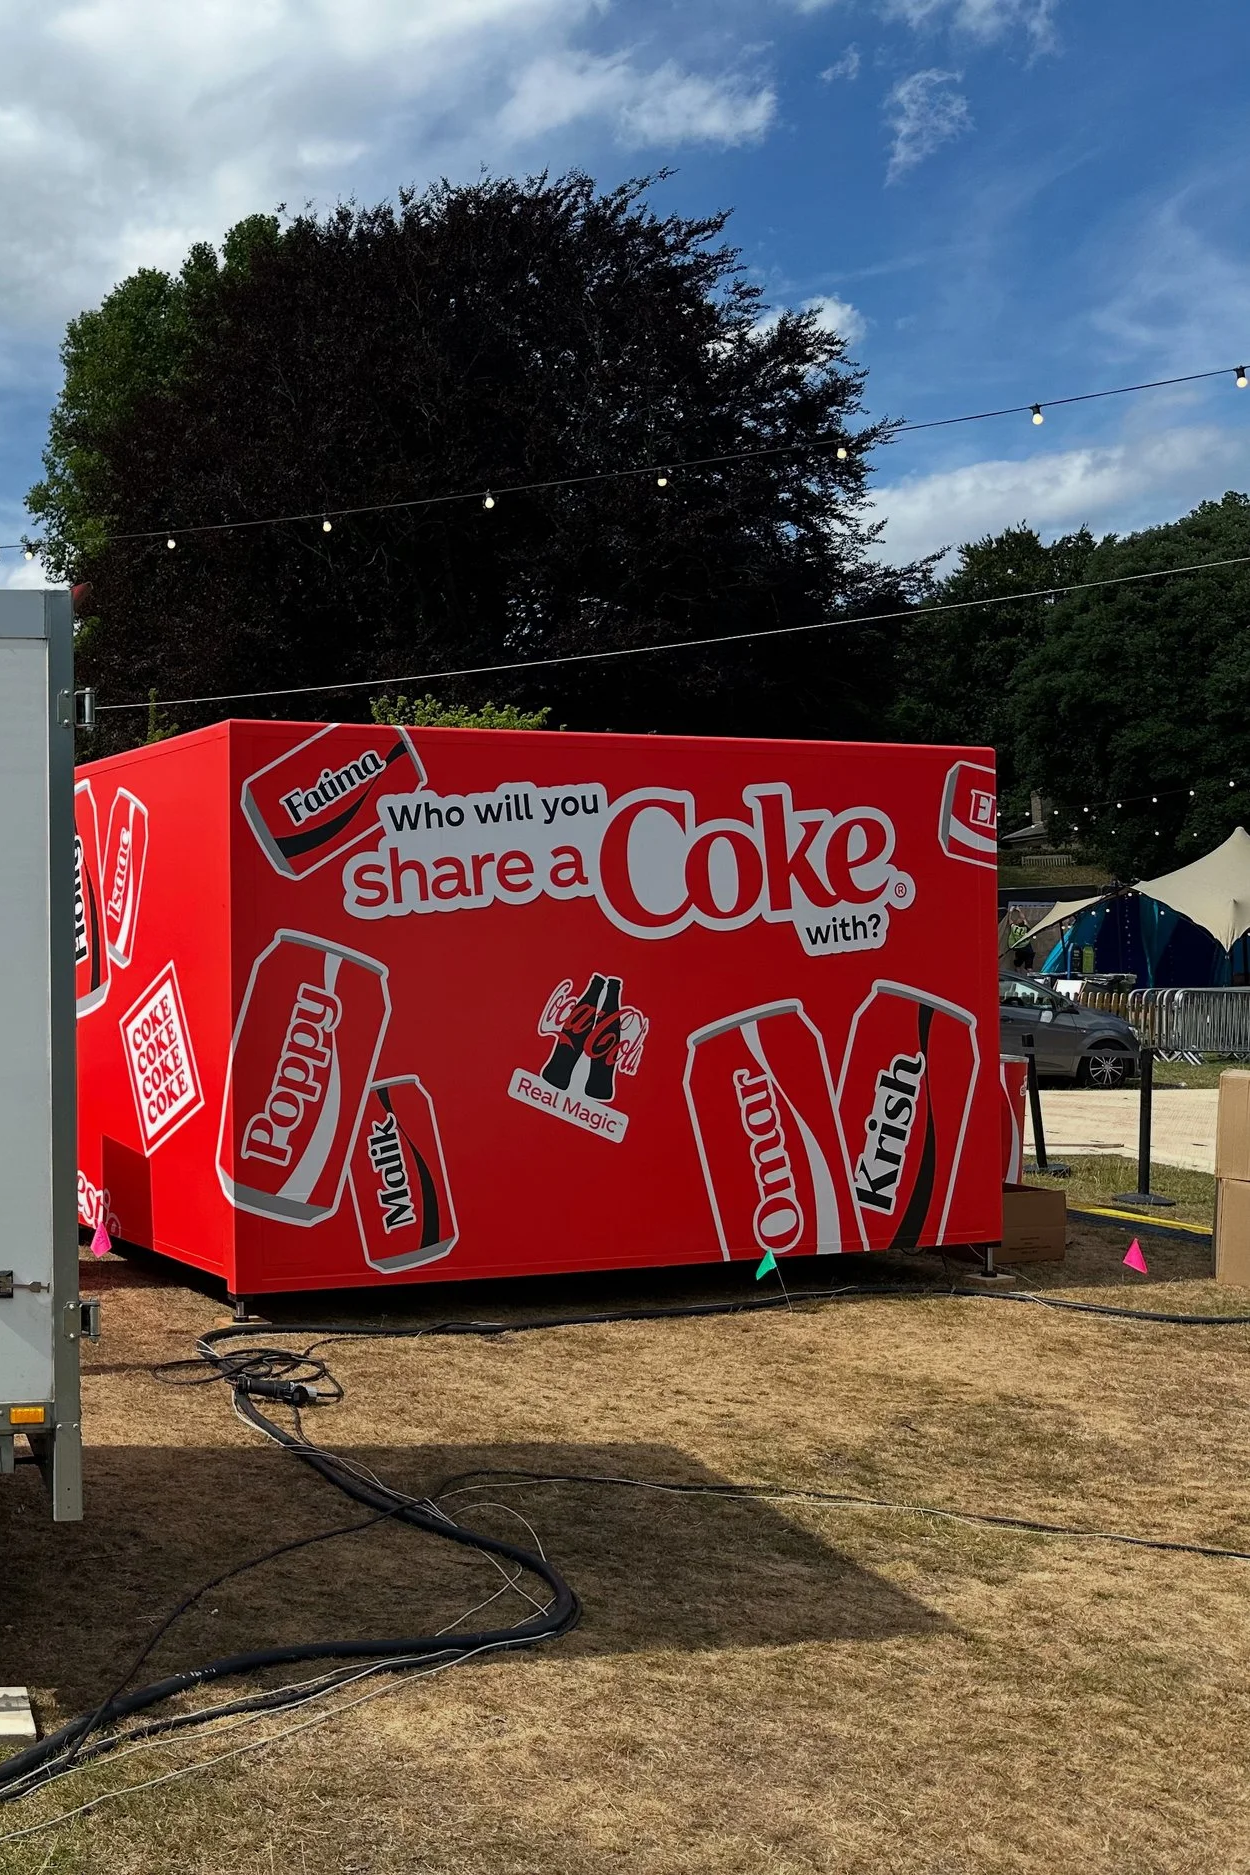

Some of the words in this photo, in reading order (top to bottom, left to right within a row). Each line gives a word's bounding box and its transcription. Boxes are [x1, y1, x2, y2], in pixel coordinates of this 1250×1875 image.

[284, 751, 383, 824] Fatima
[388, 802, 464, 831] Who
[475, 794, 533, 824] will
[541, 794, 599, 820] you
[108, 829, 129, 921] Isaac
[354, 848, 534, 907] share
[550, 845, 588, 887] a
[806, 913, 881, 945] with?
[133, 994, 171, 1051] COKE
[138, 1019, 177, 1075] COKE
[143, 1044, 182, 1099] COKE
[148, 1069, 188, 1124] COKE
[245, 985, 340, 1162] Poppy
[517, 1077, 559, 1108] Real
[736, 1072, 801, 1249] Omar
[858, 1056, 922, 1210] Krish
[374, 1117, 414, 1231] Malik
